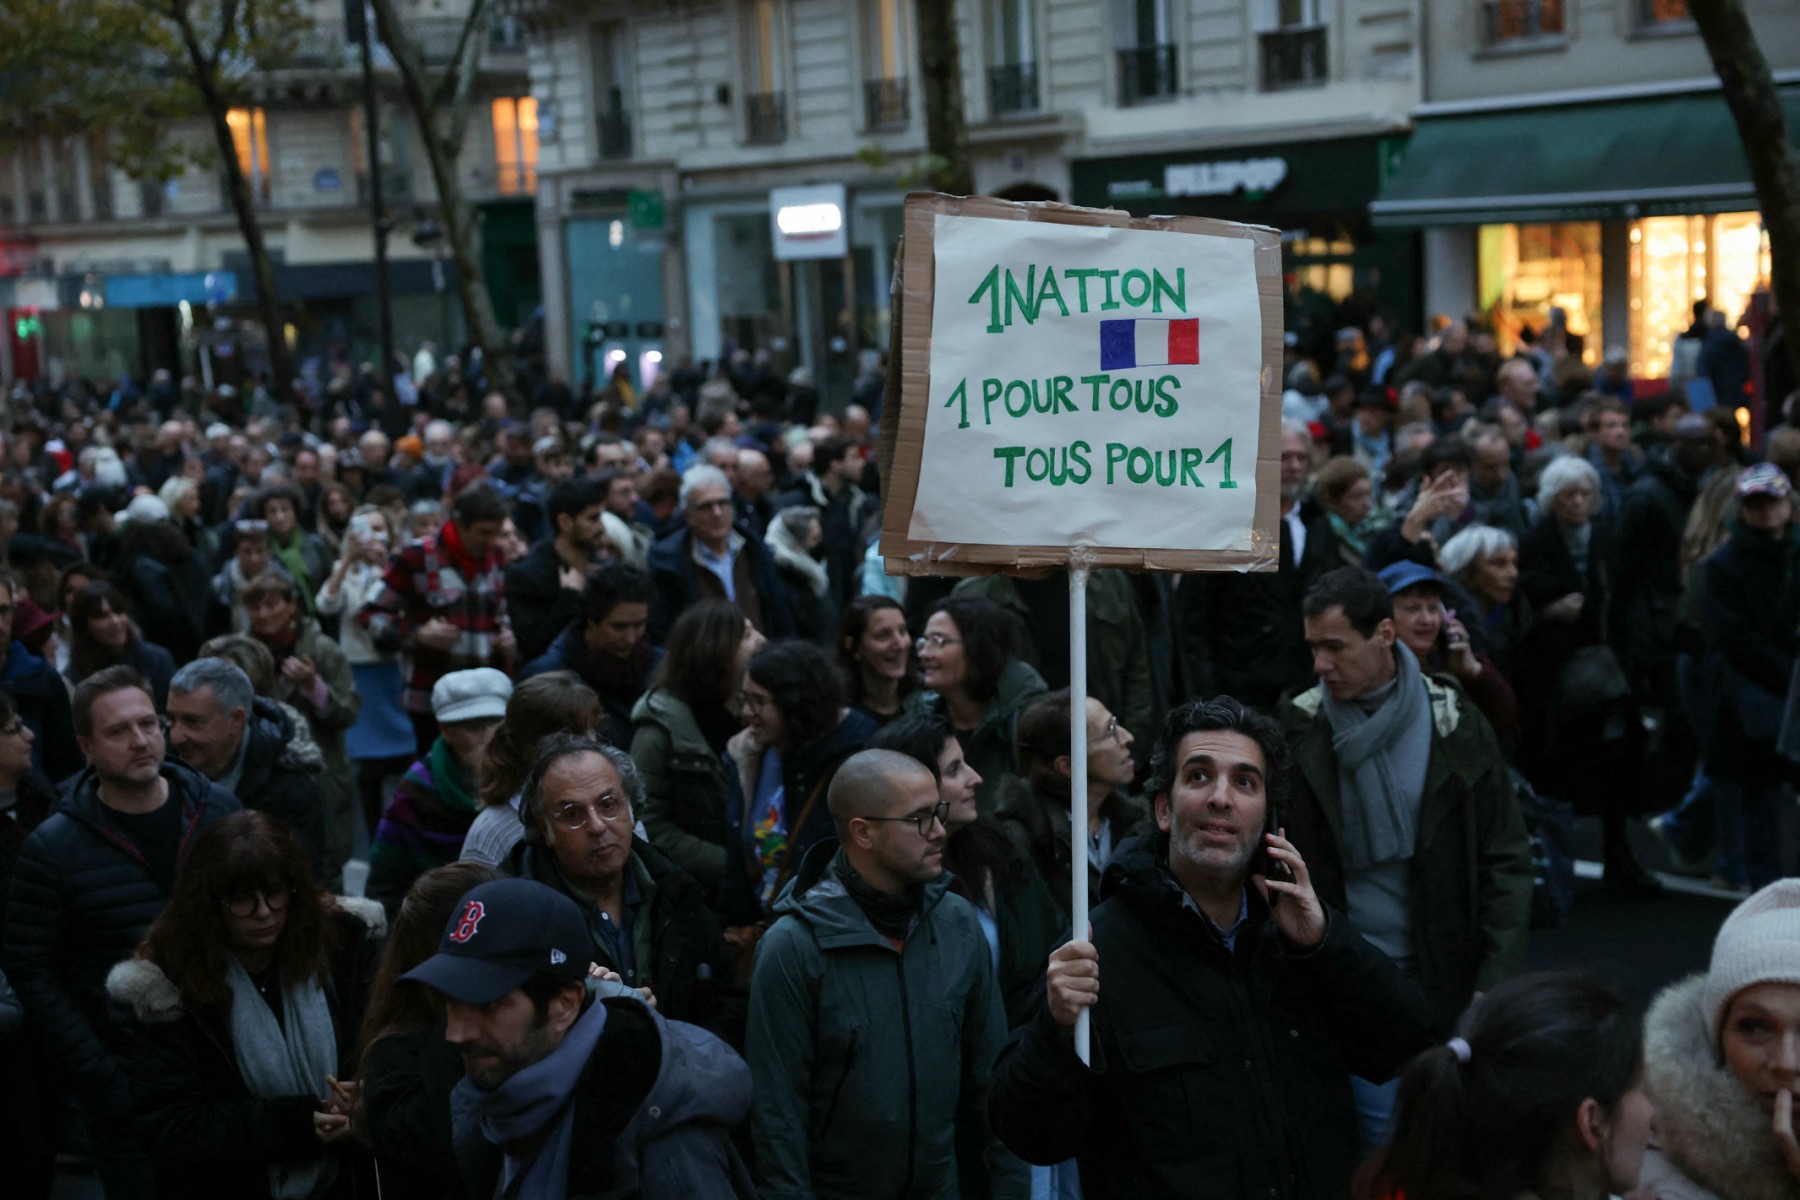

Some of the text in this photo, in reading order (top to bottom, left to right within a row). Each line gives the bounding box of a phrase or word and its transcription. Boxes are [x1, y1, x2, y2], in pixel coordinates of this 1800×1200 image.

[944, 377, 970, 429] 1
[994, 440, 1091, 488] TOUS
[449, 901, 485, 943] B
